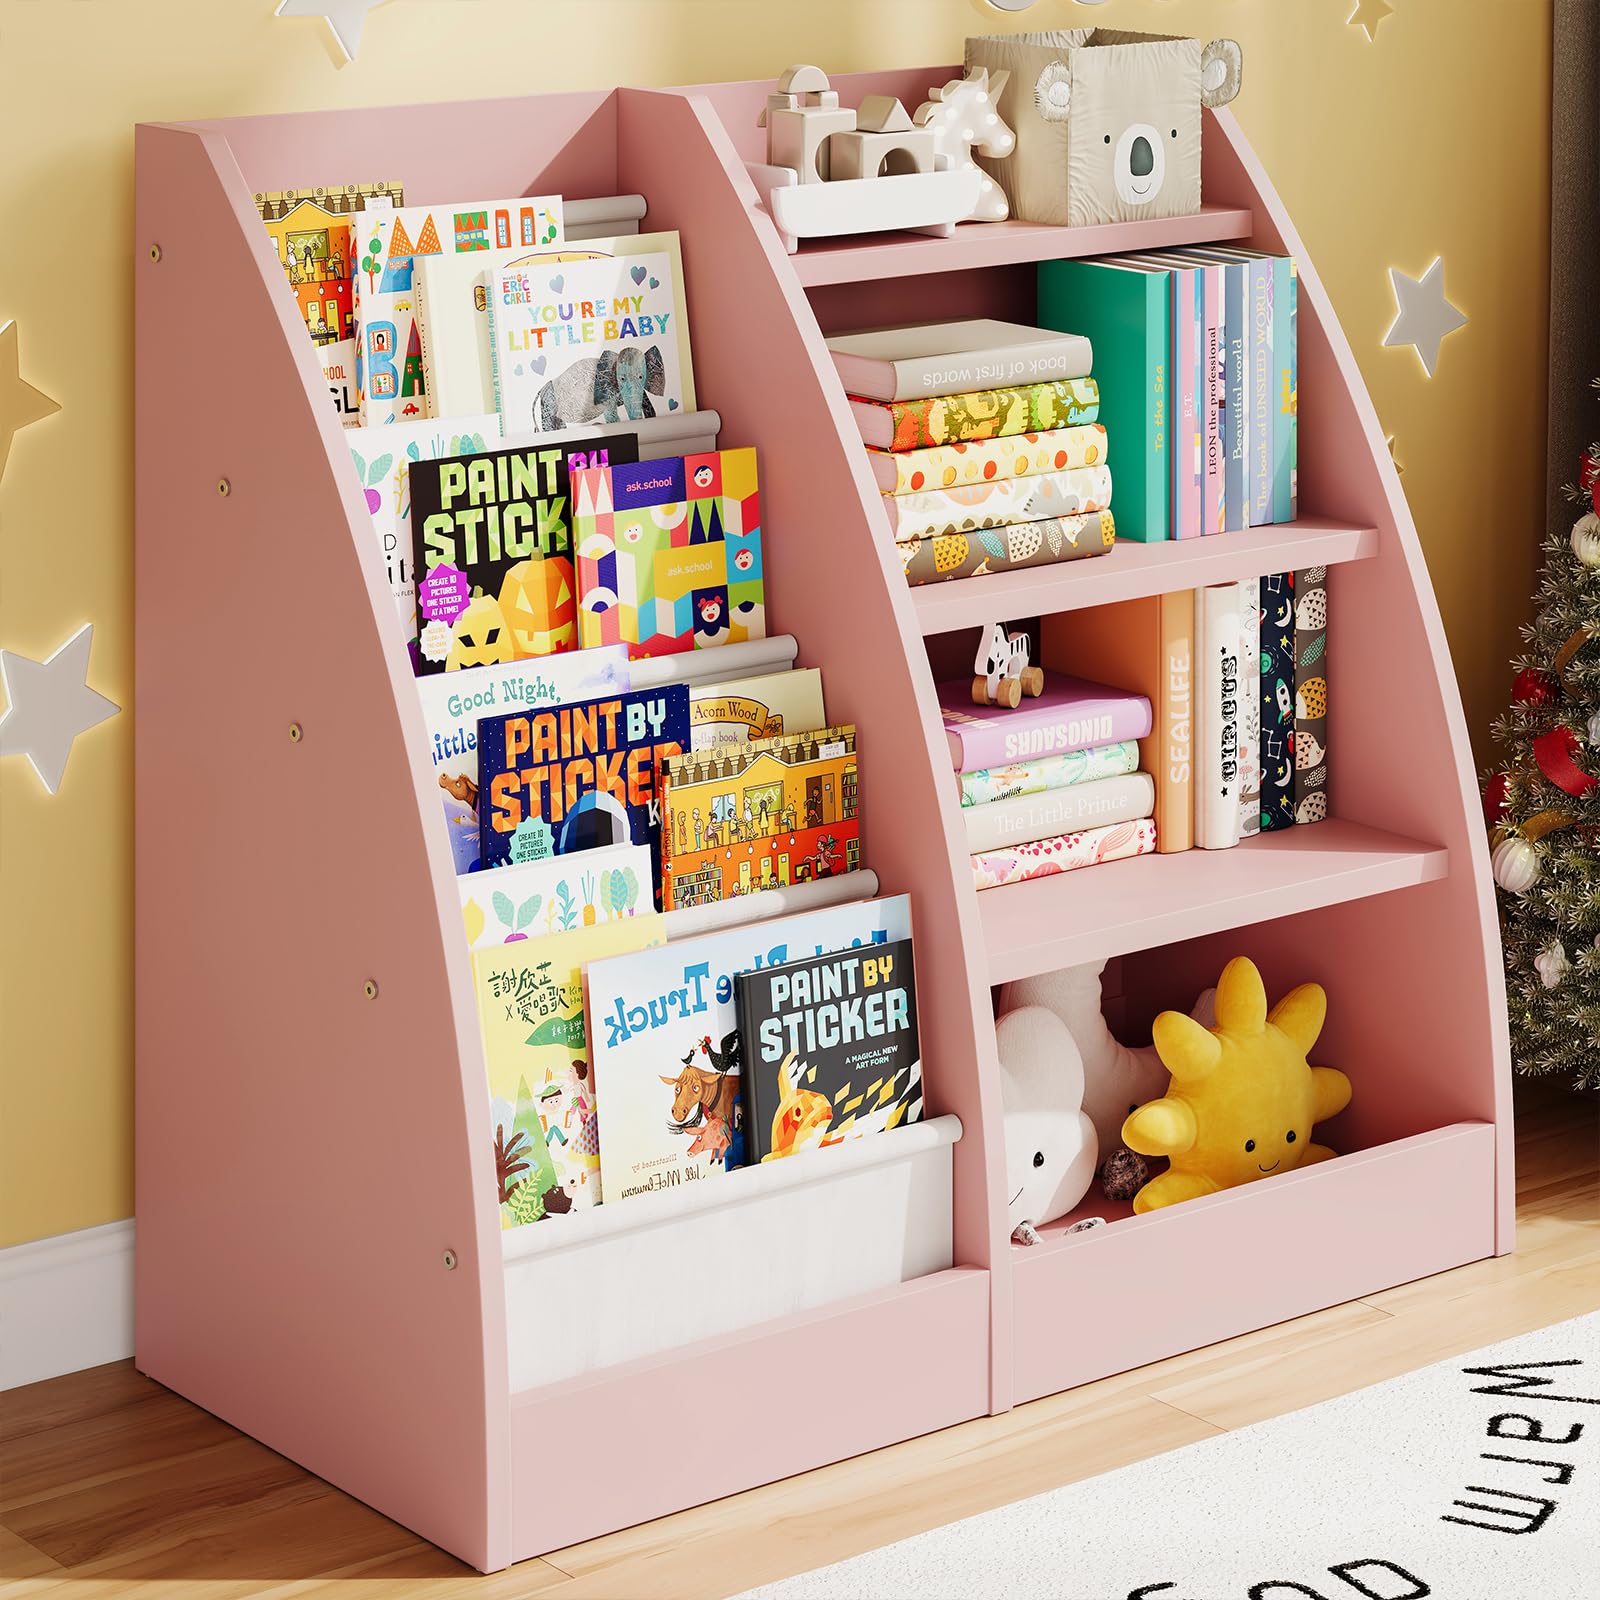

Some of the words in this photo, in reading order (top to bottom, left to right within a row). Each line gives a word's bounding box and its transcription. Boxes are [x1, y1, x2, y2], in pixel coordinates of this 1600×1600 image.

[503, 279, 530, 293] ERIC
[503, 291, 532, 306] CARLE
[528, 300, 607, 324] YOU'RE
[613, 295, 644, 316] MY
[1256, 276, 1267, 345] WORLD
[508, 321, 595, 352] LITTLE
[603, 313, 671, 342] BABY
[975, 364, 1006, 382] first
[1009, 361, 1025, 380] of
[1029, 356, 1068, 375] book
[1207, 327, 1218, 406] professional
[1232, 338, 1243, 383] world
[922, 369, 972, 389] words
[1153, 365, 1165, 393] Sea
[1153, 399, 1165, 427] the
[1184, 392, 1193, 418] E.T.
[1209, 409, 1217, 431] the
[1232, 387, 1243, 461] Beautiful
[1257, 423, 1267, 442] of
[1154, 433, 1165, 452] To
[1208, 434, 1217, 476] LEON
[1257, 444, 1267, 478] book
[439, 449, 562, 510] PAINT
[626, 476, 673, 493] ask.school
[1257, 483, 1267, 510] The
[427, 576, 449, 588] CREATE
[449, 574, 457, 584] 10
[666, 560, 713, 577] ask.school
[426, 599, 438, 608] ONE
[439, 594, 463, 606] STICKER
[430, 586, 457, 597] PICTURES
[431, 607, 439, 617] AT
[444, 604, 459, 615] TIME!
[447, 682, 496, 718] Good
[502, 675, 562, 705] Night,
[694, 703, 726, 720] Acorn
[727, 700, 759, 722] Wood
[1170, 656, 1191, 785] SEALIFE
[1220, 655, 1238, 783] CIRCUS
[505, 700, 622, 769] PAINT
[626, 698, 667, 742] BY
[718, 731, 739, 743] book
[1005, 714, 1113, 759] DINOSAURS
[992, 811, 1025, 834] The
[1029, 803, 1073, 826] Little
[1078, 793, 1128, 818] Prince
[518, 832, 537, 842] CREATE
[537, 829, 544, 839] 10
[520, 838, 544, 850] PICTURES
[663, 828, 672, 862] ENGLISH
[516, 850, 526, 860] ONE
[527, 846, 548, 858] STICKER
[770, 958, 860, 1013] PAINT
[863, 954, 894, 988] BY
[759, 987, 910, 1064] STICKER
[845, 1056, 851, 1065] A
[851, 1049, 881, 1064] MAGICAL
[882, 1045, 899, 1056] NEW
[855, 1060, 869, 1071] ART
[870, 1056, 890, 1067] FORM
[1440, 1358, 1600, 1536] Warm
